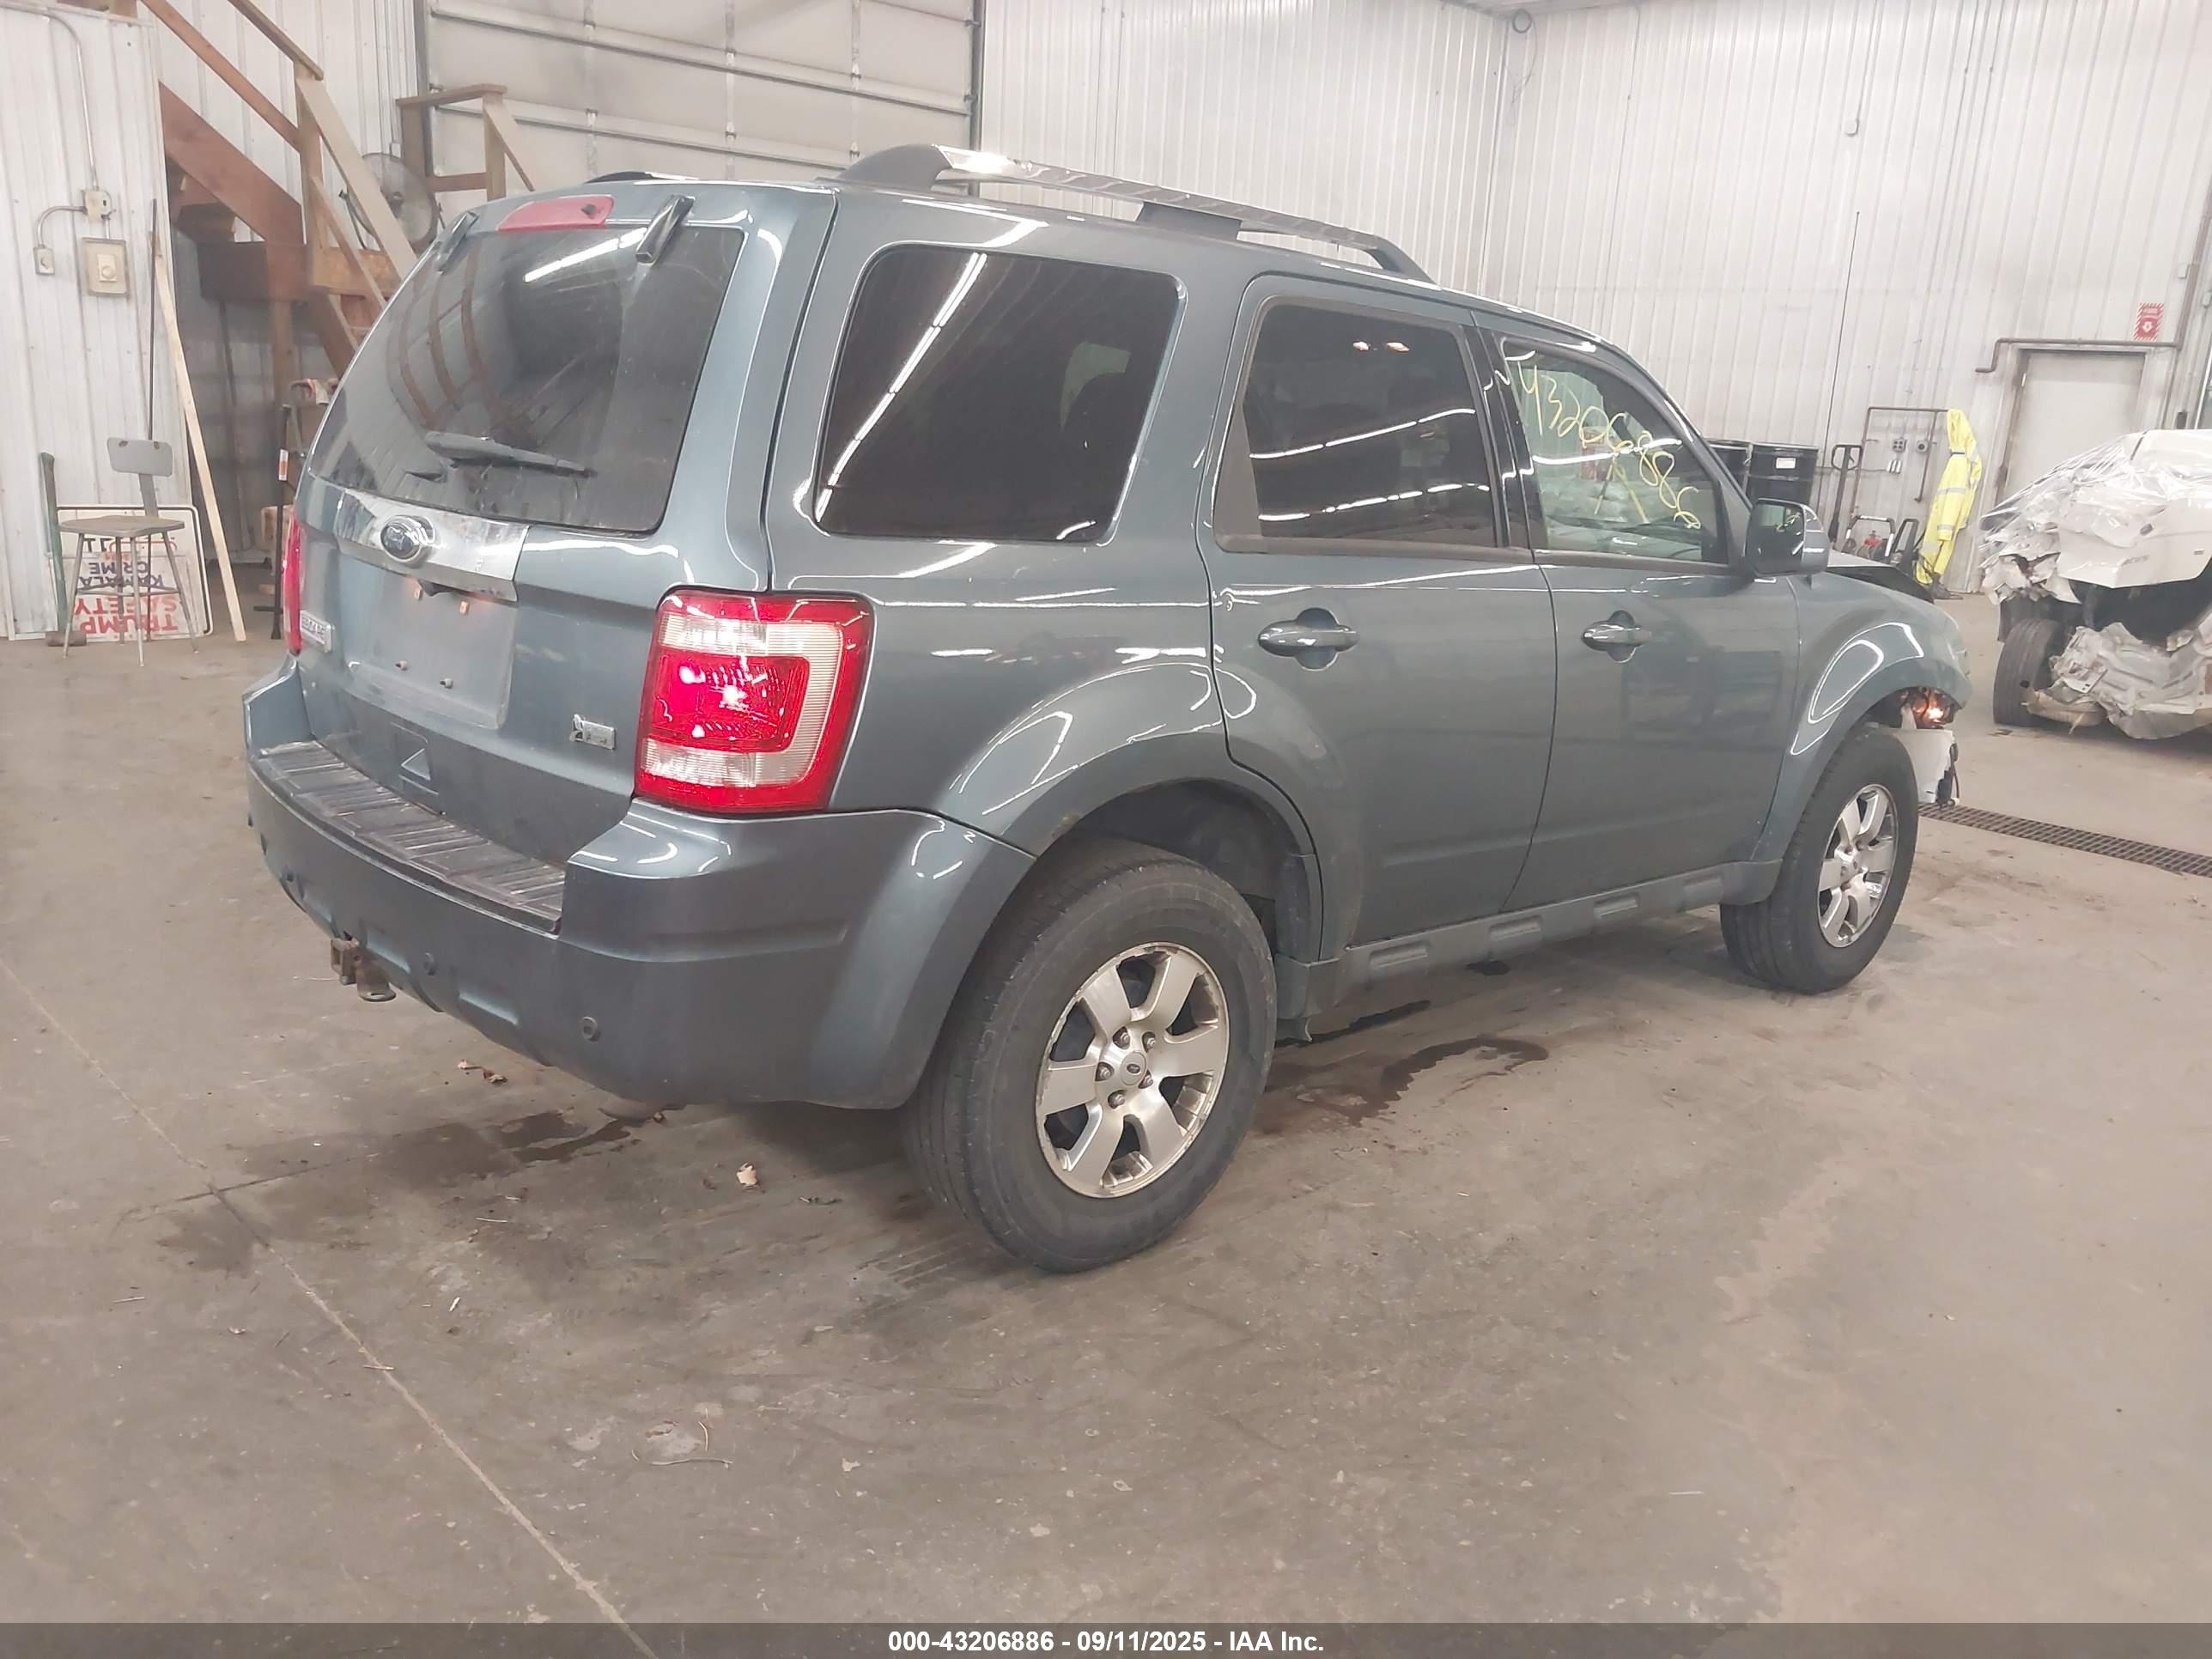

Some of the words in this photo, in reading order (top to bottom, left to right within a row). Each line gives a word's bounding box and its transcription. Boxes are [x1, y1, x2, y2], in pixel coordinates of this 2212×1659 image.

[88, 561, 149, 574] CRME
[75, 595, 178, 617] SAFETY
[79, 613, 179, 635] TRUMP
